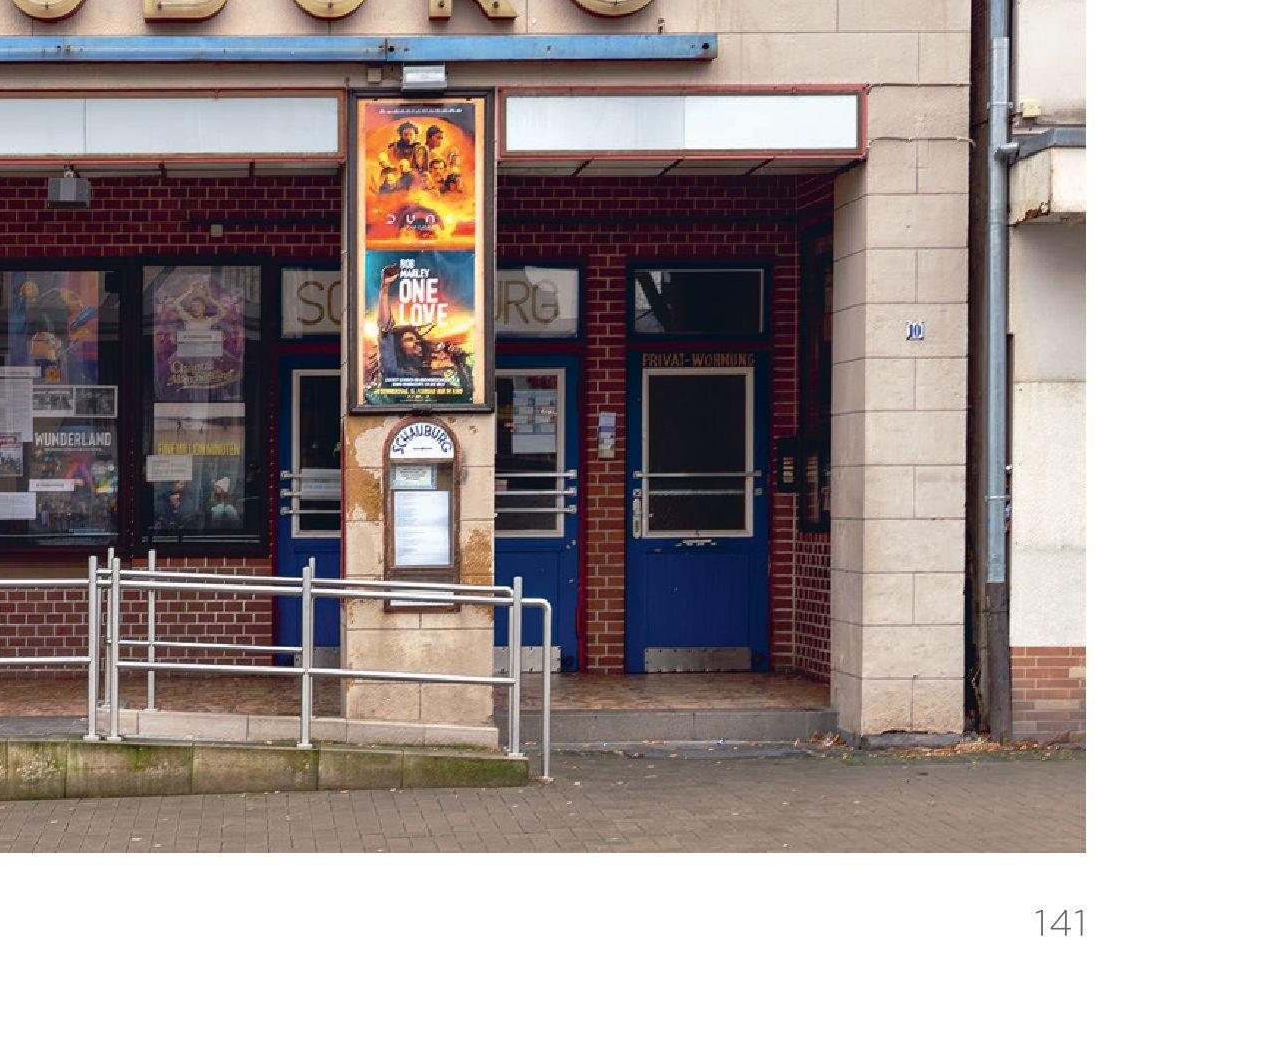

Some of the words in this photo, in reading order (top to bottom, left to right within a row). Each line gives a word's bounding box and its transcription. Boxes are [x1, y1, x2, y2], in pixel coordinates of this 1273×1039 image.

[399, 278, 439, 303] ONE
[399, 303, 449, 327] LOVE
[34, 431, 112, 447] WUNDERLAND
[392, 424, 452, 455] SCHAUBURG
